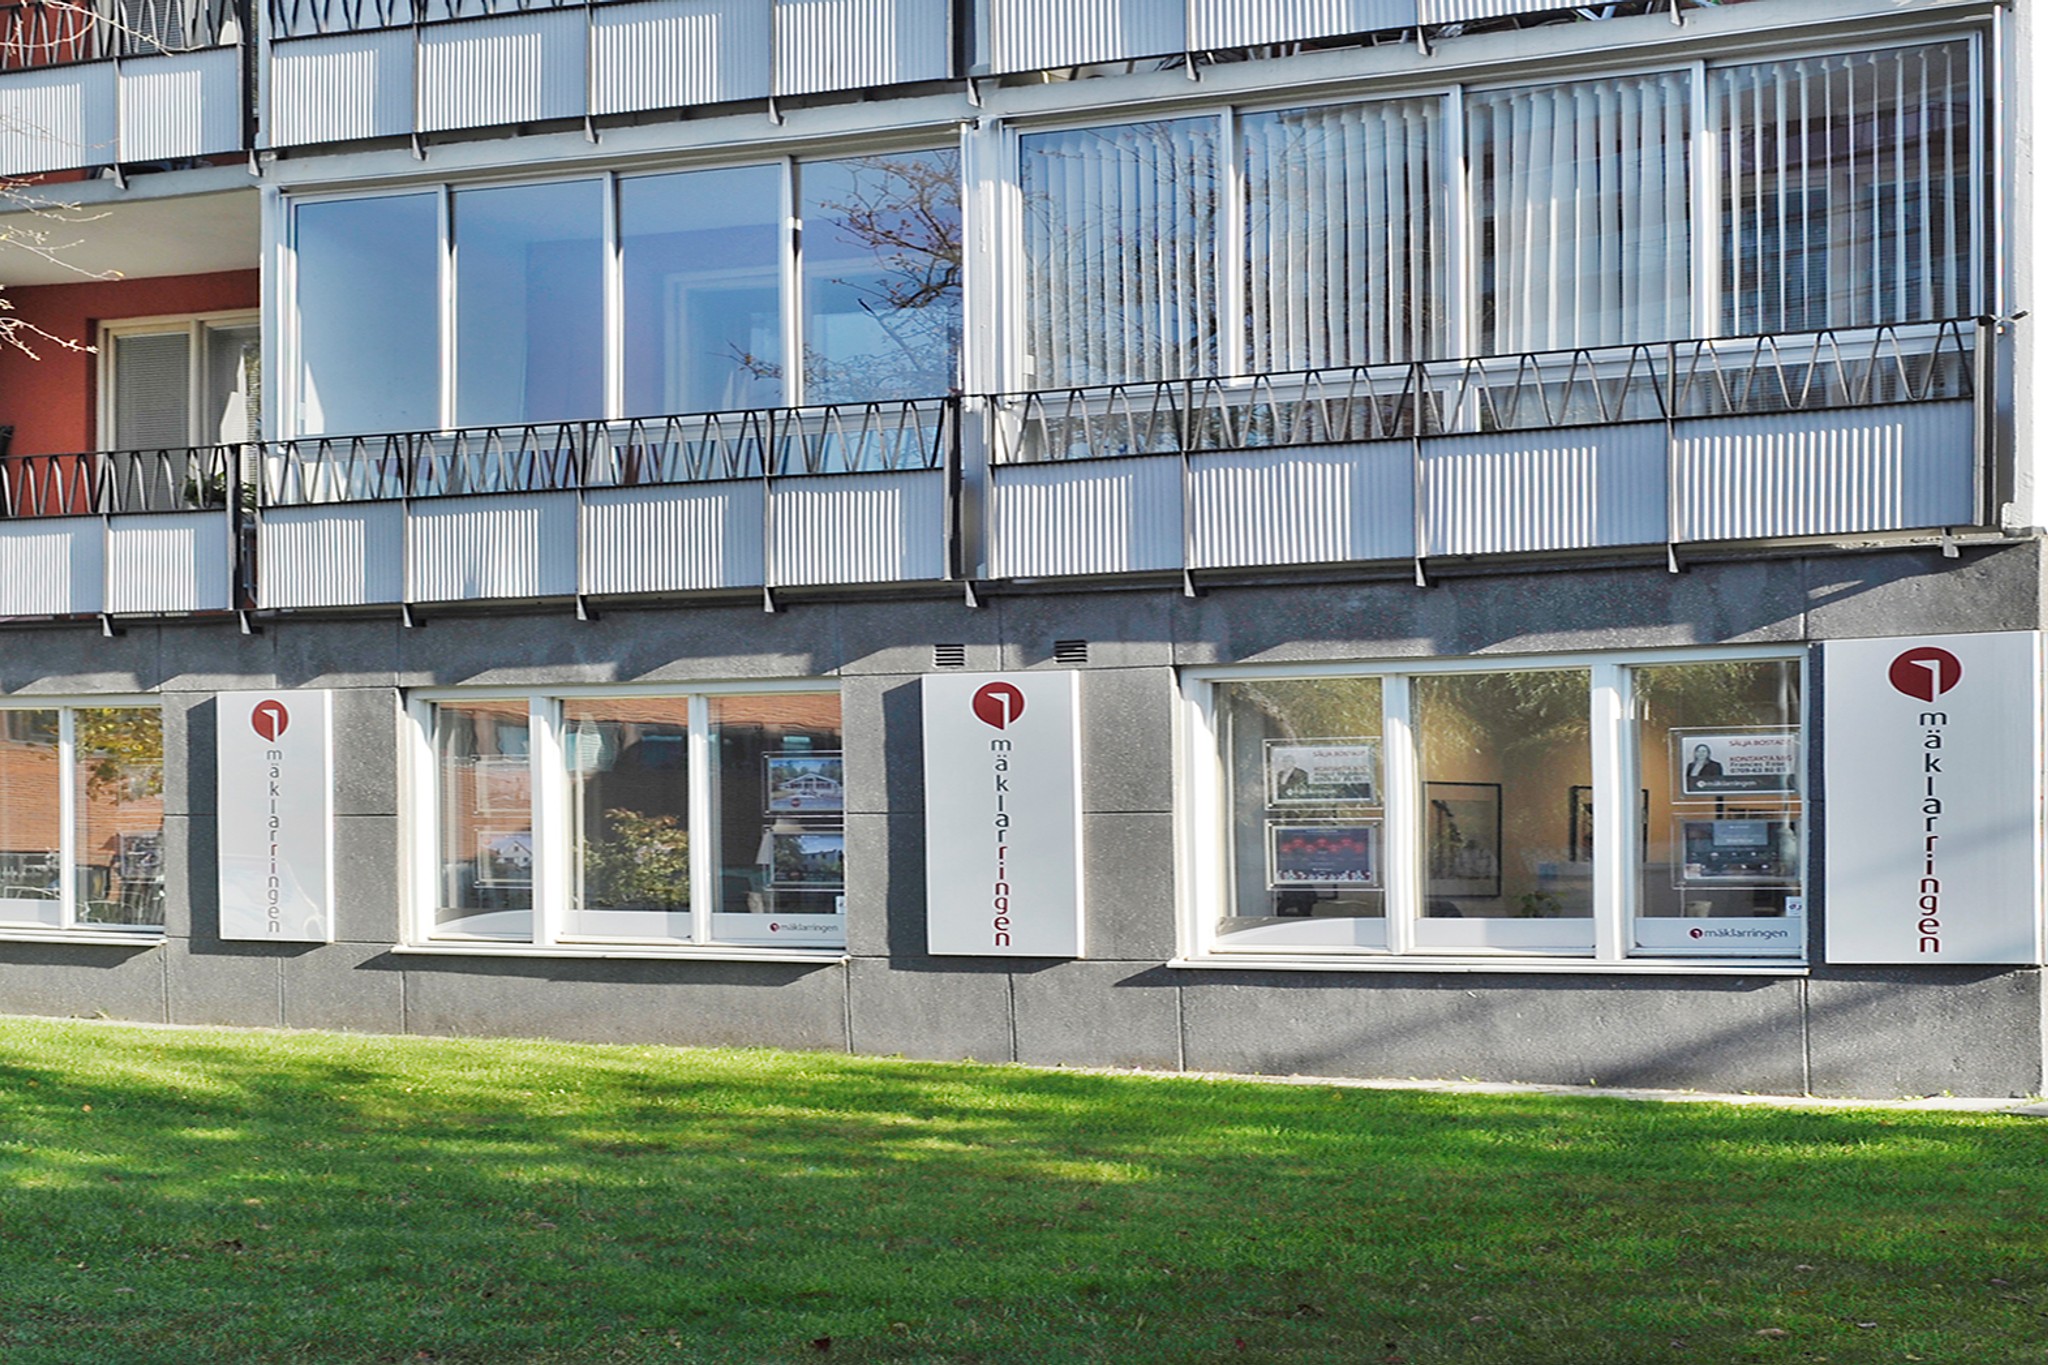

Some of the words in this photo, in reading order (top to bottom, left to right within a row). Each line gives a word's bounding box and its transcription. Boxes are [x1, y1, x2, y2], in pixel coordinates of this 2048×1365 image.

[266, 749, 283, 933] mäklarringen
[990, 739, 1012, 947] mäklarringen
[1917, 711, 1949, 953] mäklarringen
[1704, 928, 1789, 941] mäklarringen
